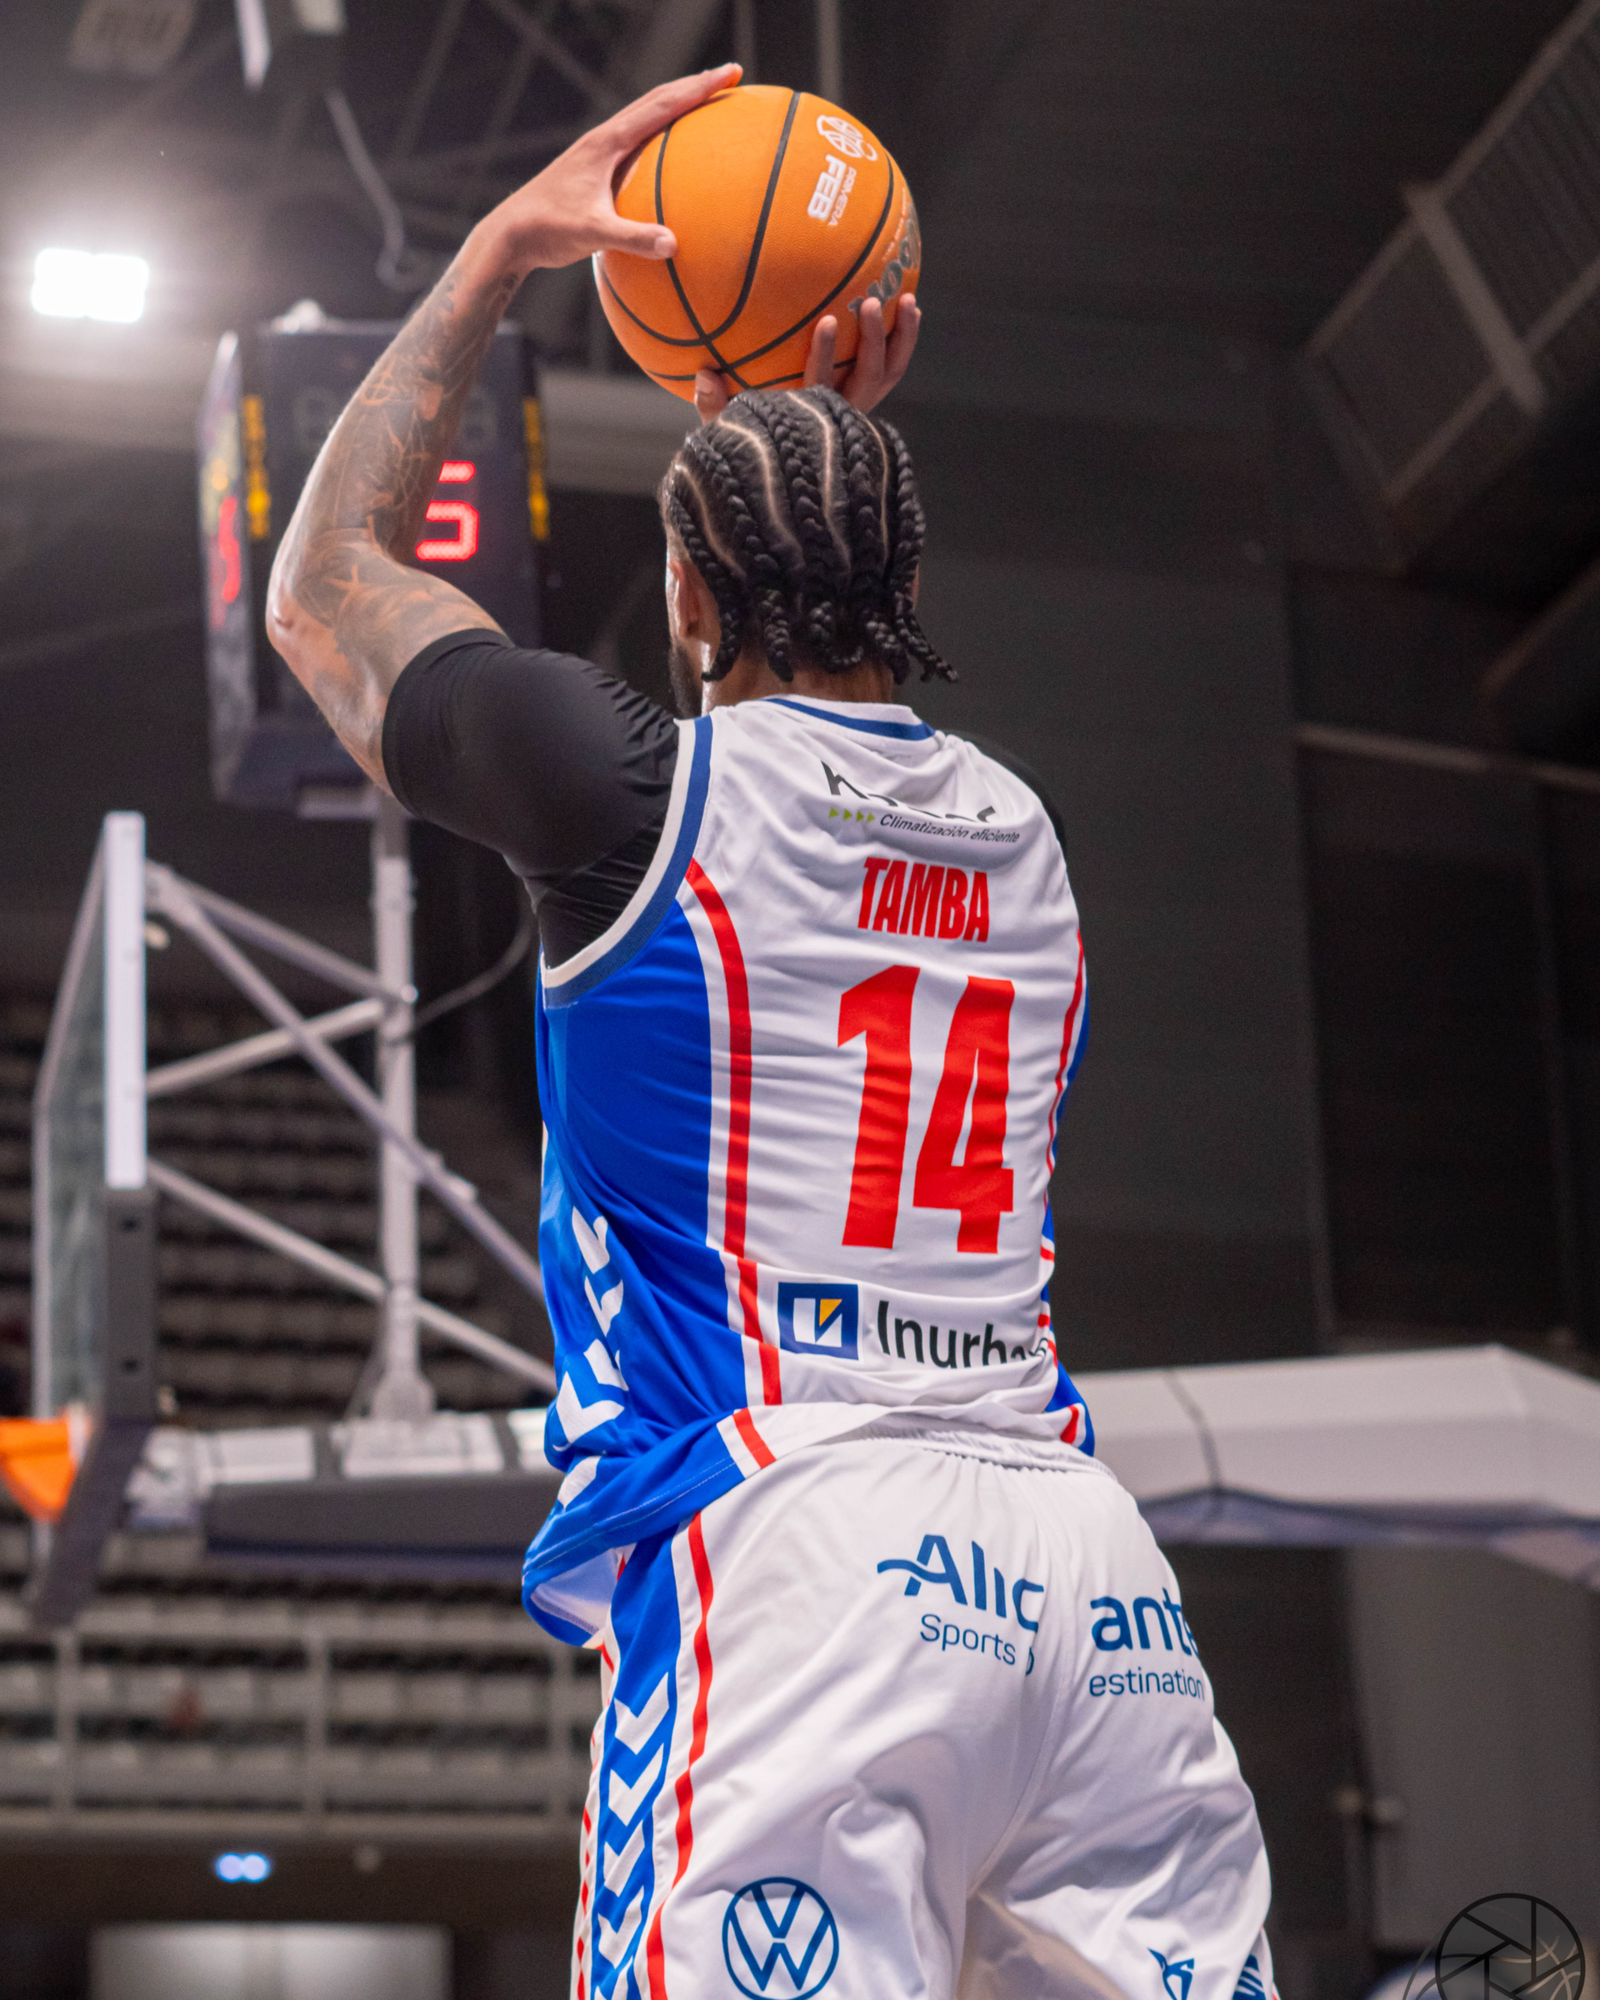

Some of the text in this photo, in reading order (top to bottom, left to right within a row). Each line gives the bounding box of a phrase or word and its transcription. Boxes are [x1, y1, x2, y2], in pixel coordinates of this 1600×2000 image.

[807, 154, 846, 220] FEB
[880, 813, 1020, 843] Climatización eficiente
[857, 856, 990, 942] TAMBA
[837, 964, 1015, 1254] 14
[920, 1614, 1016, 1665] Sports
